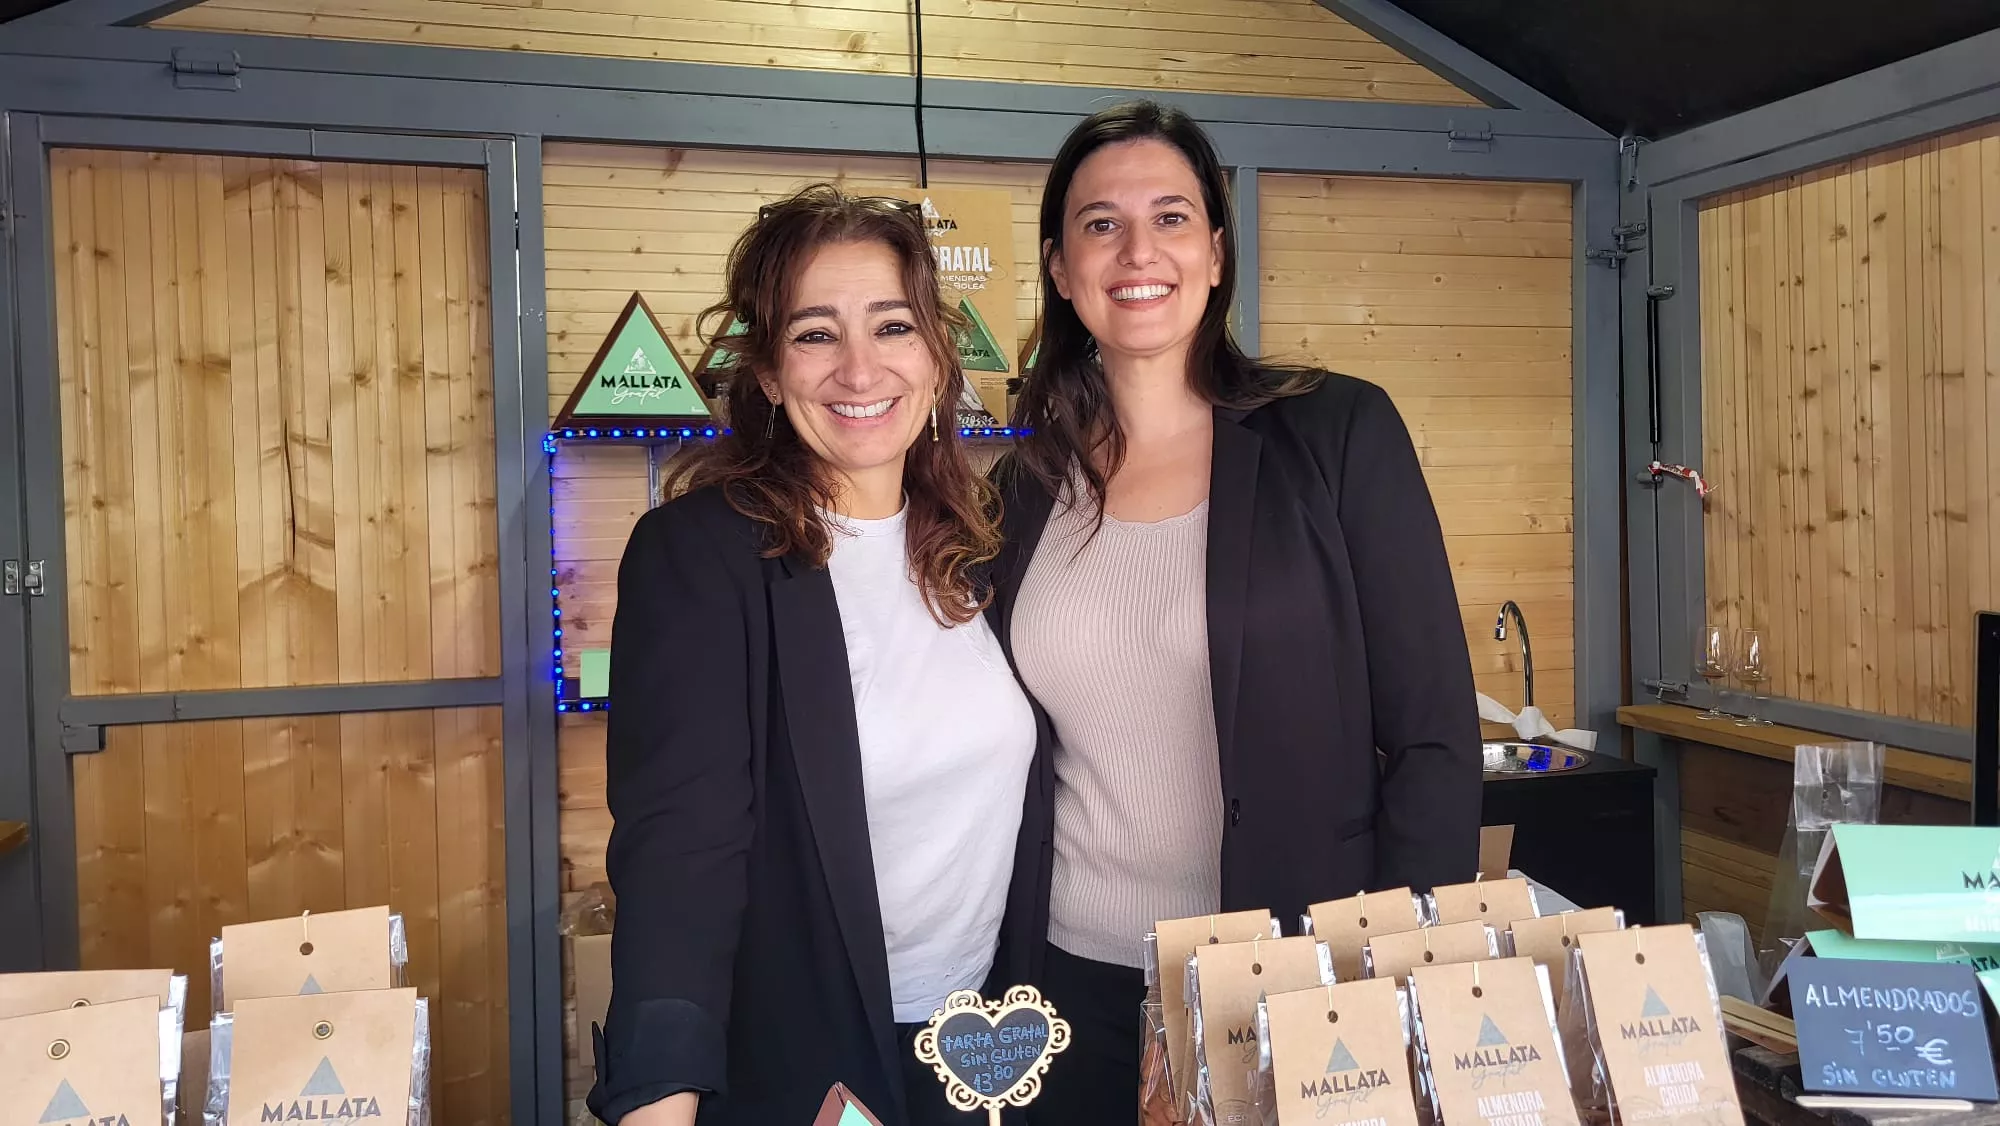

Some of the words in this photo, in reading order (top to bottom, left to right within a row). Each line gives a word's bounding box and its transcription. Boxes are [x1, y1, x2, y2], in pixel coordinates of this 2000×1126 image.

[936, 245, 993, 272] RATAL
[942, 275, 987, 283] MENDRAS
[601, 375, 682, 388] MALLATA
[1805, 983, 1978, 1017] ALMENDRADOS
[1620, 1016, 1701, 1040] MALLATA
[1454, 1044, 1542, 1070] MALLATA
[1300, 1068, 1391, 1099] MALLATA
[1643, 1061, 1705, 1087] ALMENDRA
[1871, 1067, 1956, 1088] GLUTEN
[1477, 1090, 1545, 1118] ALMENDRA
[1659, 1083, 1700, 1107] CRUDA
[261, 1096, 381, 1123] MALLATA
